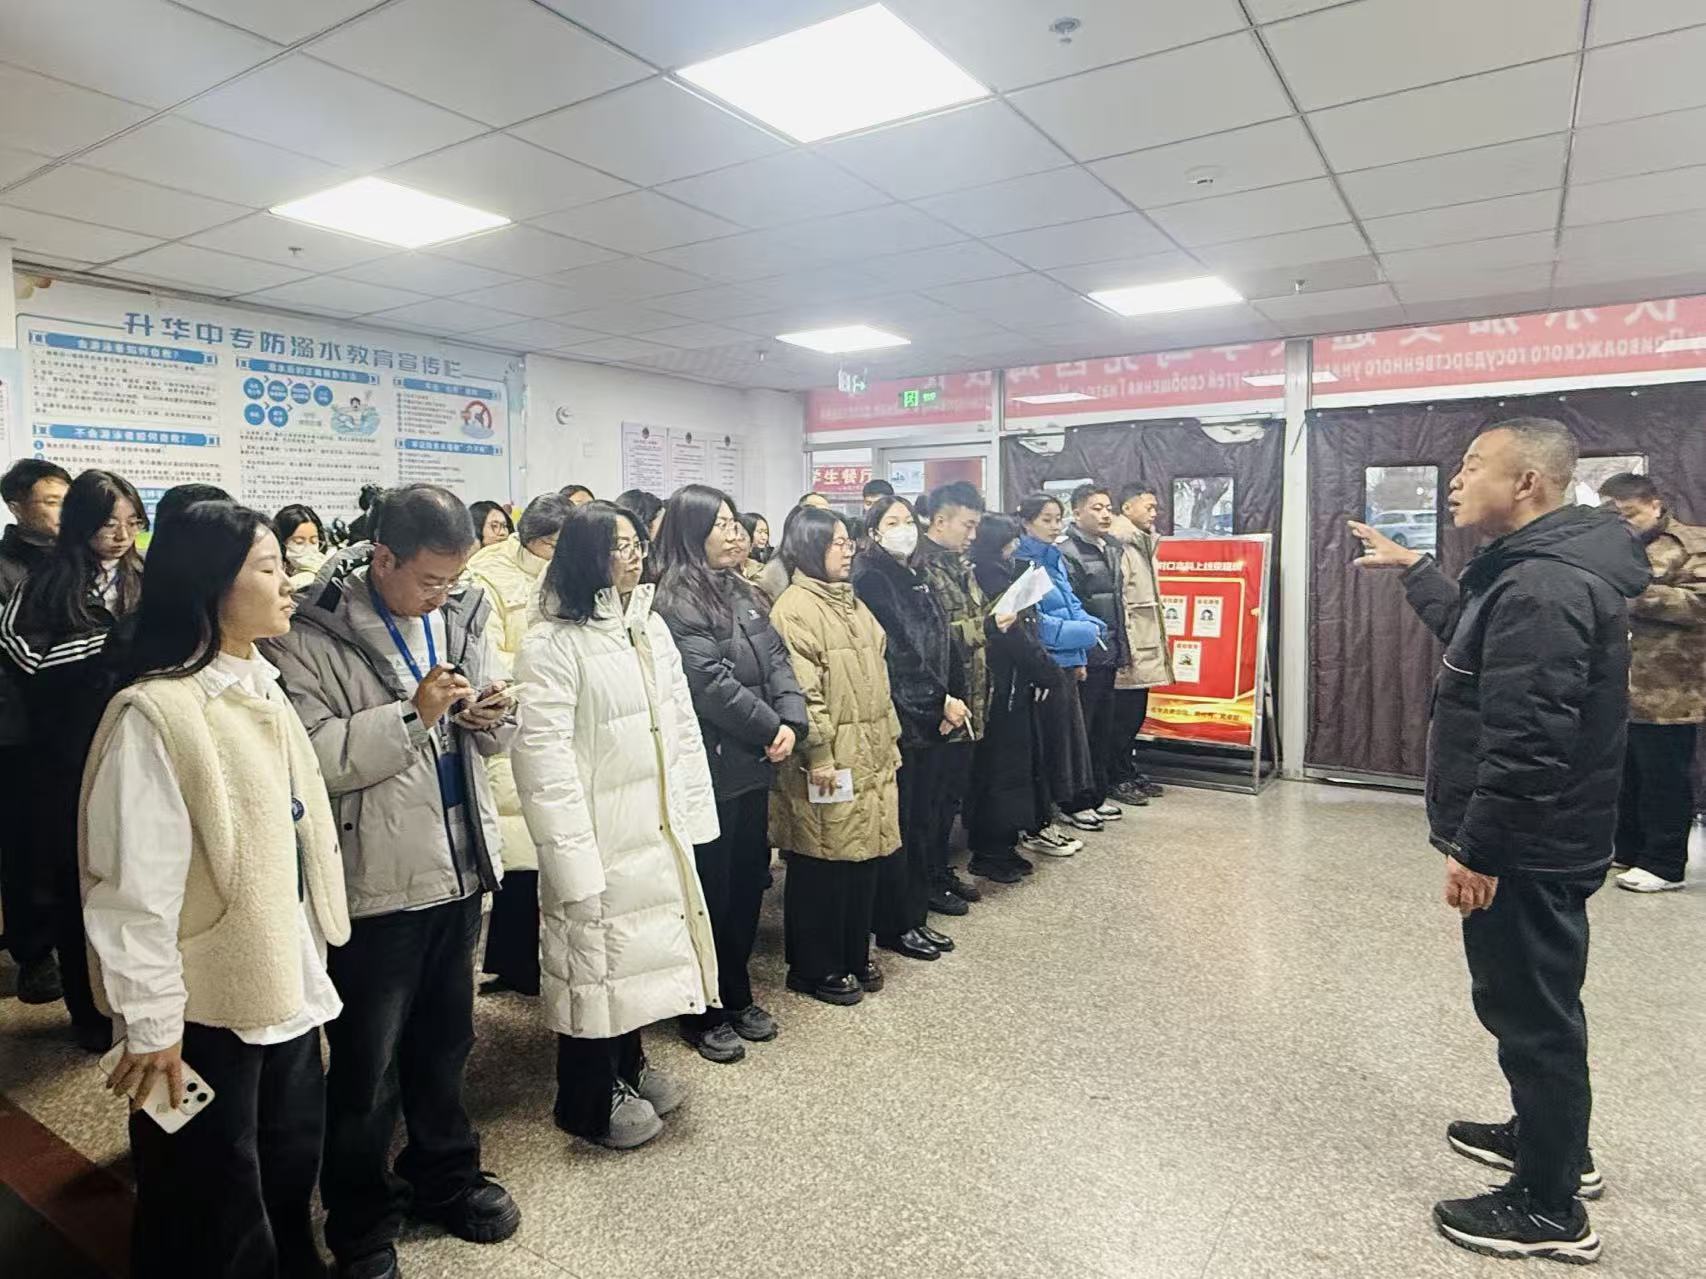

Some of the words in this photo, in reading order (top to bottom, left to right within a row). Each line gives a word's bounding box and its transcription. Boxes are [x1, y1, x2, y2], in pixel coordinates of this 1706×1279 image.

[122, 312, 463, 379] 升华中专防溺水教育宣传栏
